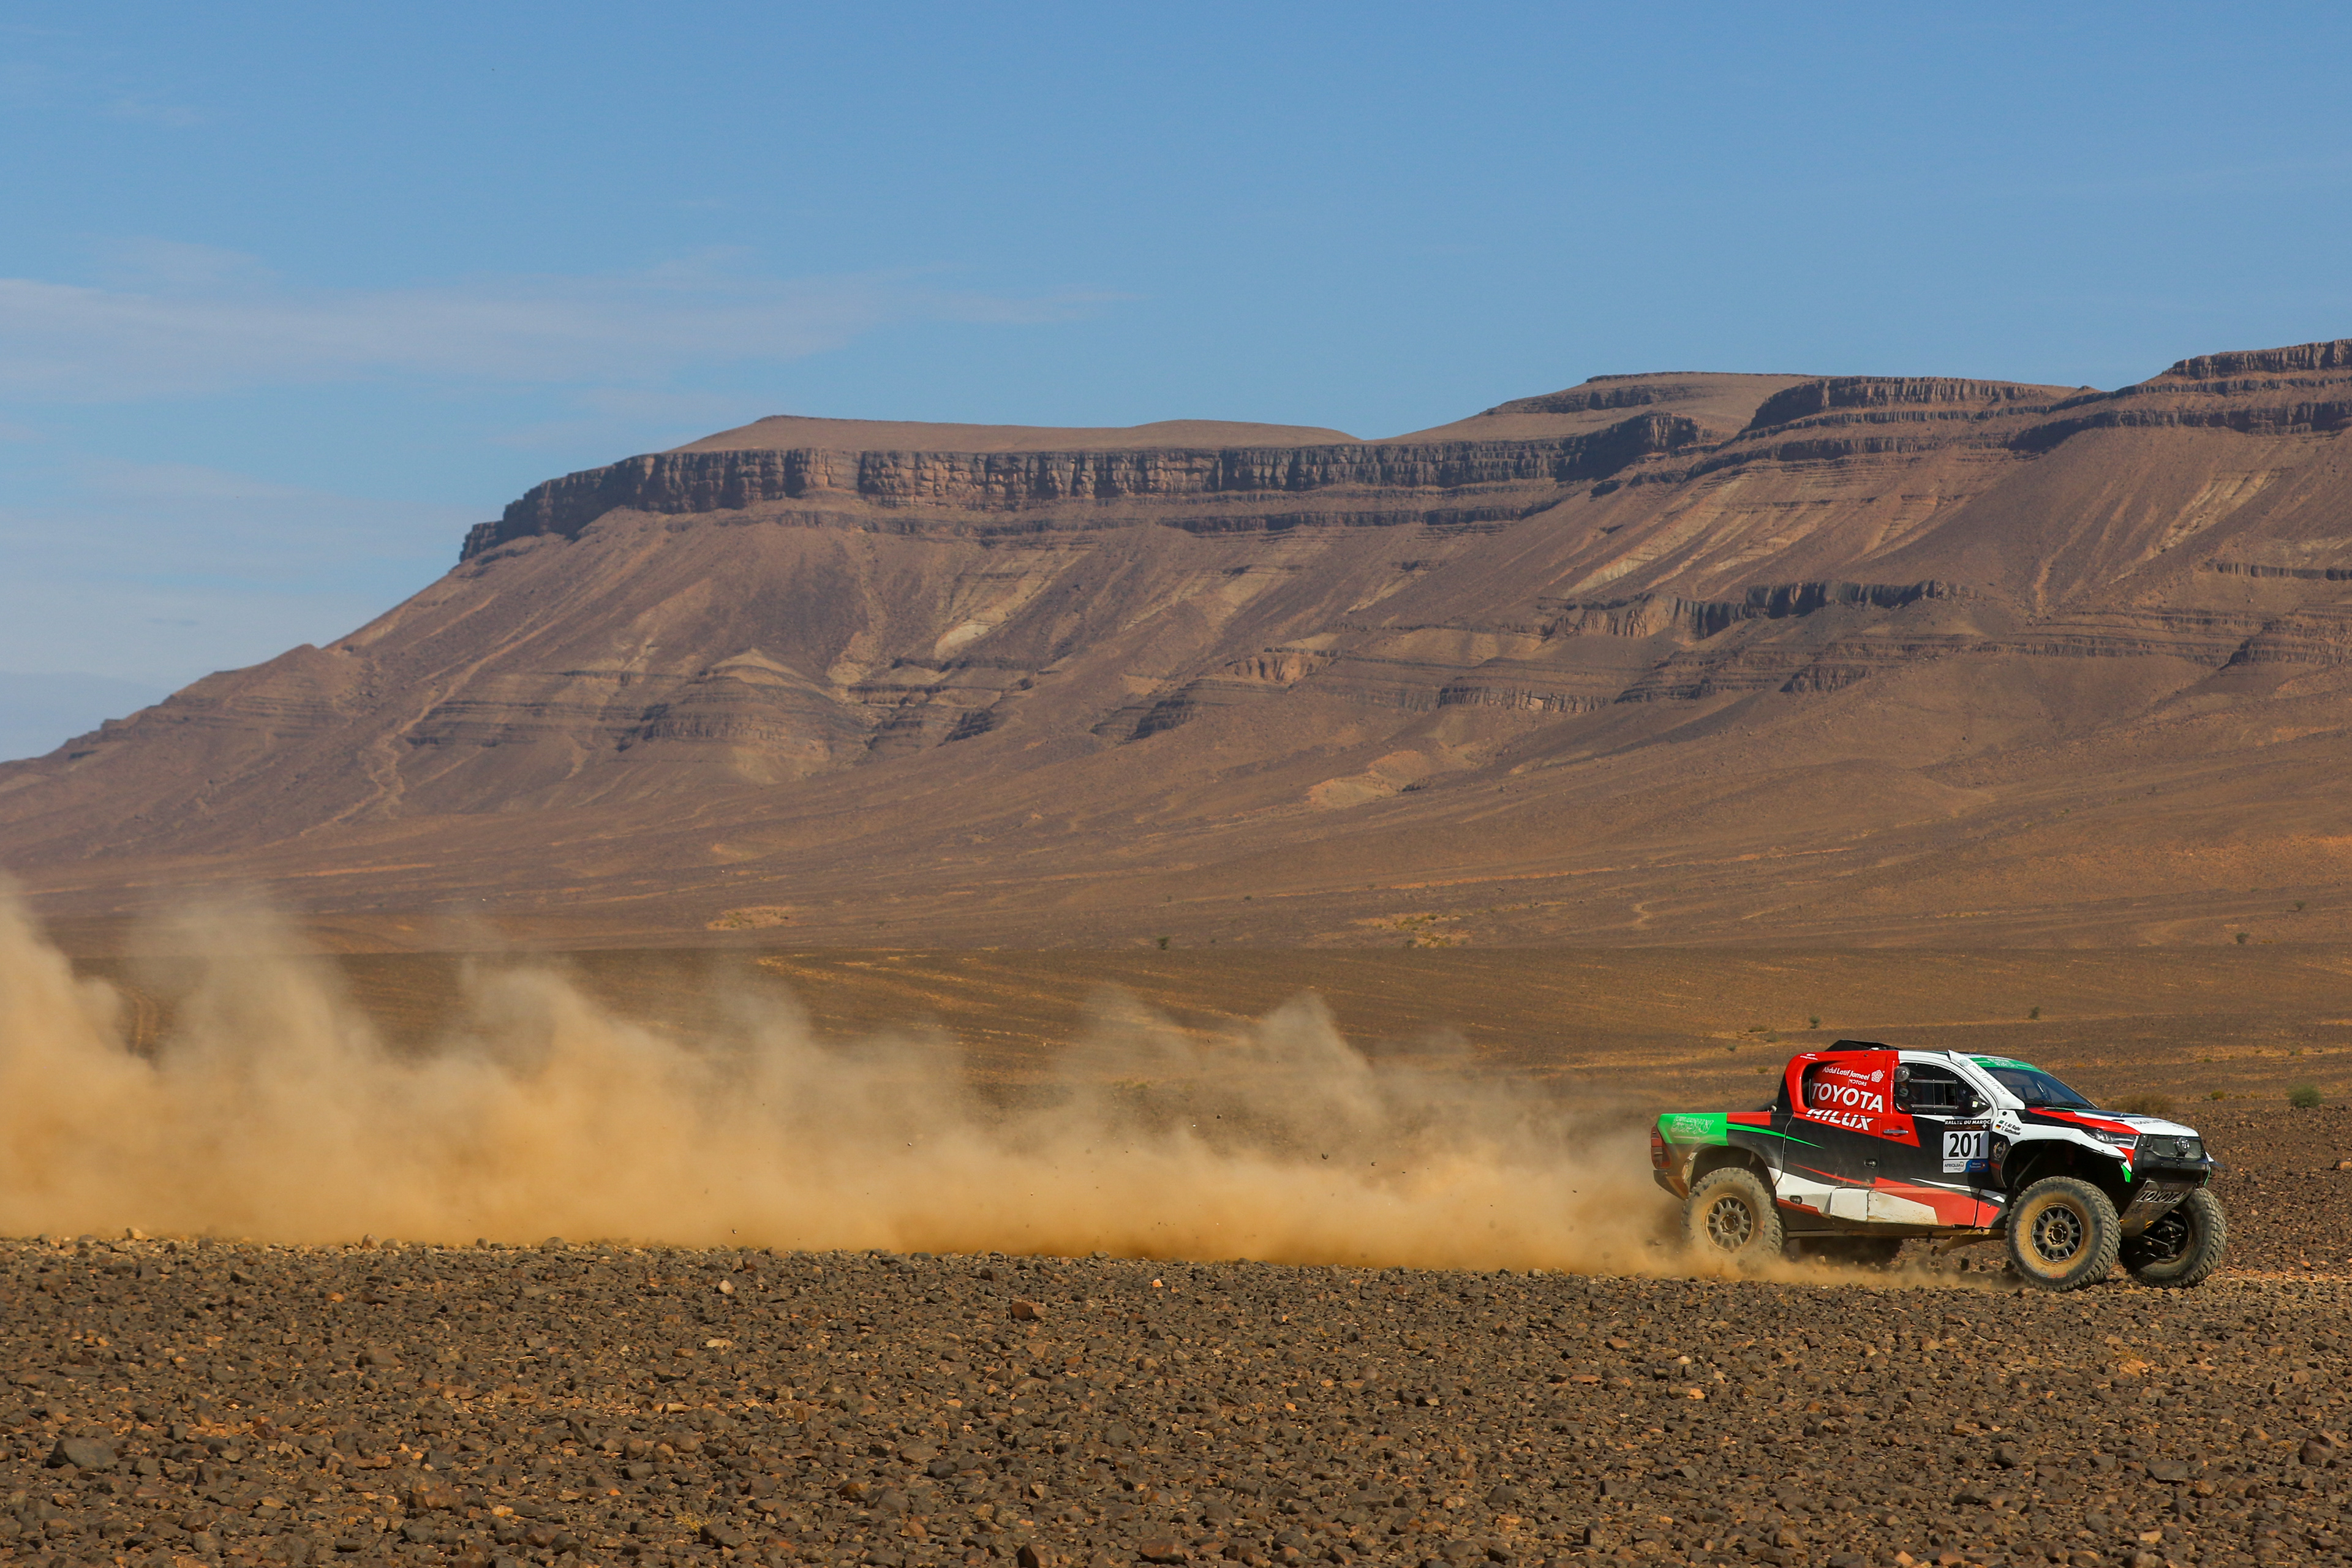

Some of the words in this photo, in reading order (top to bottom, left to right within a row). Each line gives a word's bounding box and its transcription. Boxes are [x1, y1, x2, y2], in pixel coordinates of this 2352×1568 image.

[1837, 1068, 1850, 1076] Latif
[1849, 1071, 1871, 1080] Jameel
[1811, 1082, 1883, 1113] TOYOTA
[1948, 1133, 1980, 1157] 201
[2136, 1190, 2187, 1203] TOYOTA
